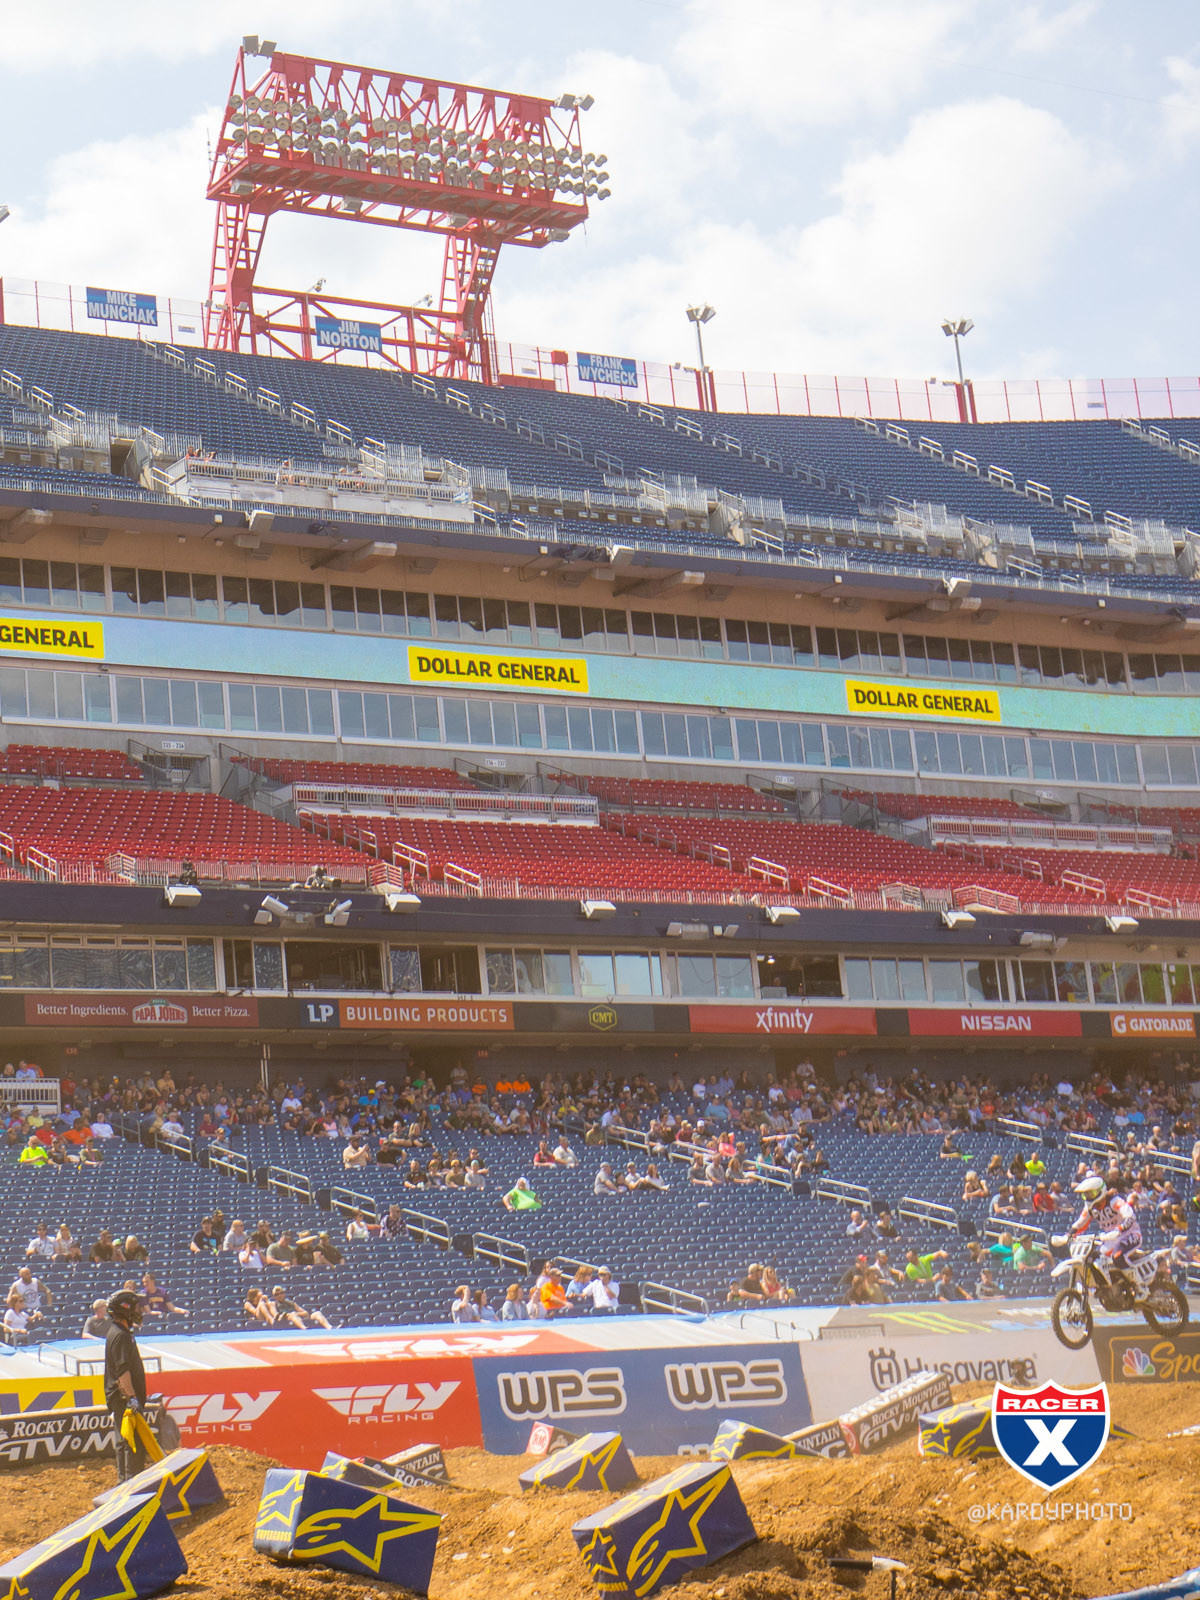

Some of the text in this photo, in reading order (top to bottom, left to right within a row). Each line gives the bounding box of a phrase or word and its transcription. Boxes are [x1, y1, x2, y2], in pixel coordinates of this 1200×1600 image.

[106, 291, 137, 307] MIKE
[88, 302, 156, 325] MUNCHAK
[338, 320, 360, 335] JIM
[320, 330, 379, 351] NORTON
[590, 354, 623, 370] FRANK
[580, 365, 637, 387] WYCHECK
[417, 656, 580, 684] DOLLAR GENERAL
[853, 688, 993, 714] DOLLAR GENERAL
[36, 1003, 130, 1018] Better Ingredients.
[135, 1006, 157, 1021] PAPA
[191, 1006, 251, 1018] Better Pizza.
[307, 1004, 335, 1023] LP
[346, 1006, 508, 1024] BUILDING PRODUCTS
[756, 1006, 814, 1033] xfinity
[961, 1015, 1031, 1032] NISSAN
[1130, 1017, 1193, 1033] GATORADE
[666, 1359, 787, 1408] WPS
[312, 1381, 462, 1416] FLY
[499, 1368, 626, 1419] WPS
[872, 1404, 900, 1428] ROCKY
[902, 1379, 948, 1412] MOUNTAIN
[179, 1422, 253, 1434] ACING
[348, 1412, 434, 1425] RACING
[11, 1419, 66, 1438] ROCKY
